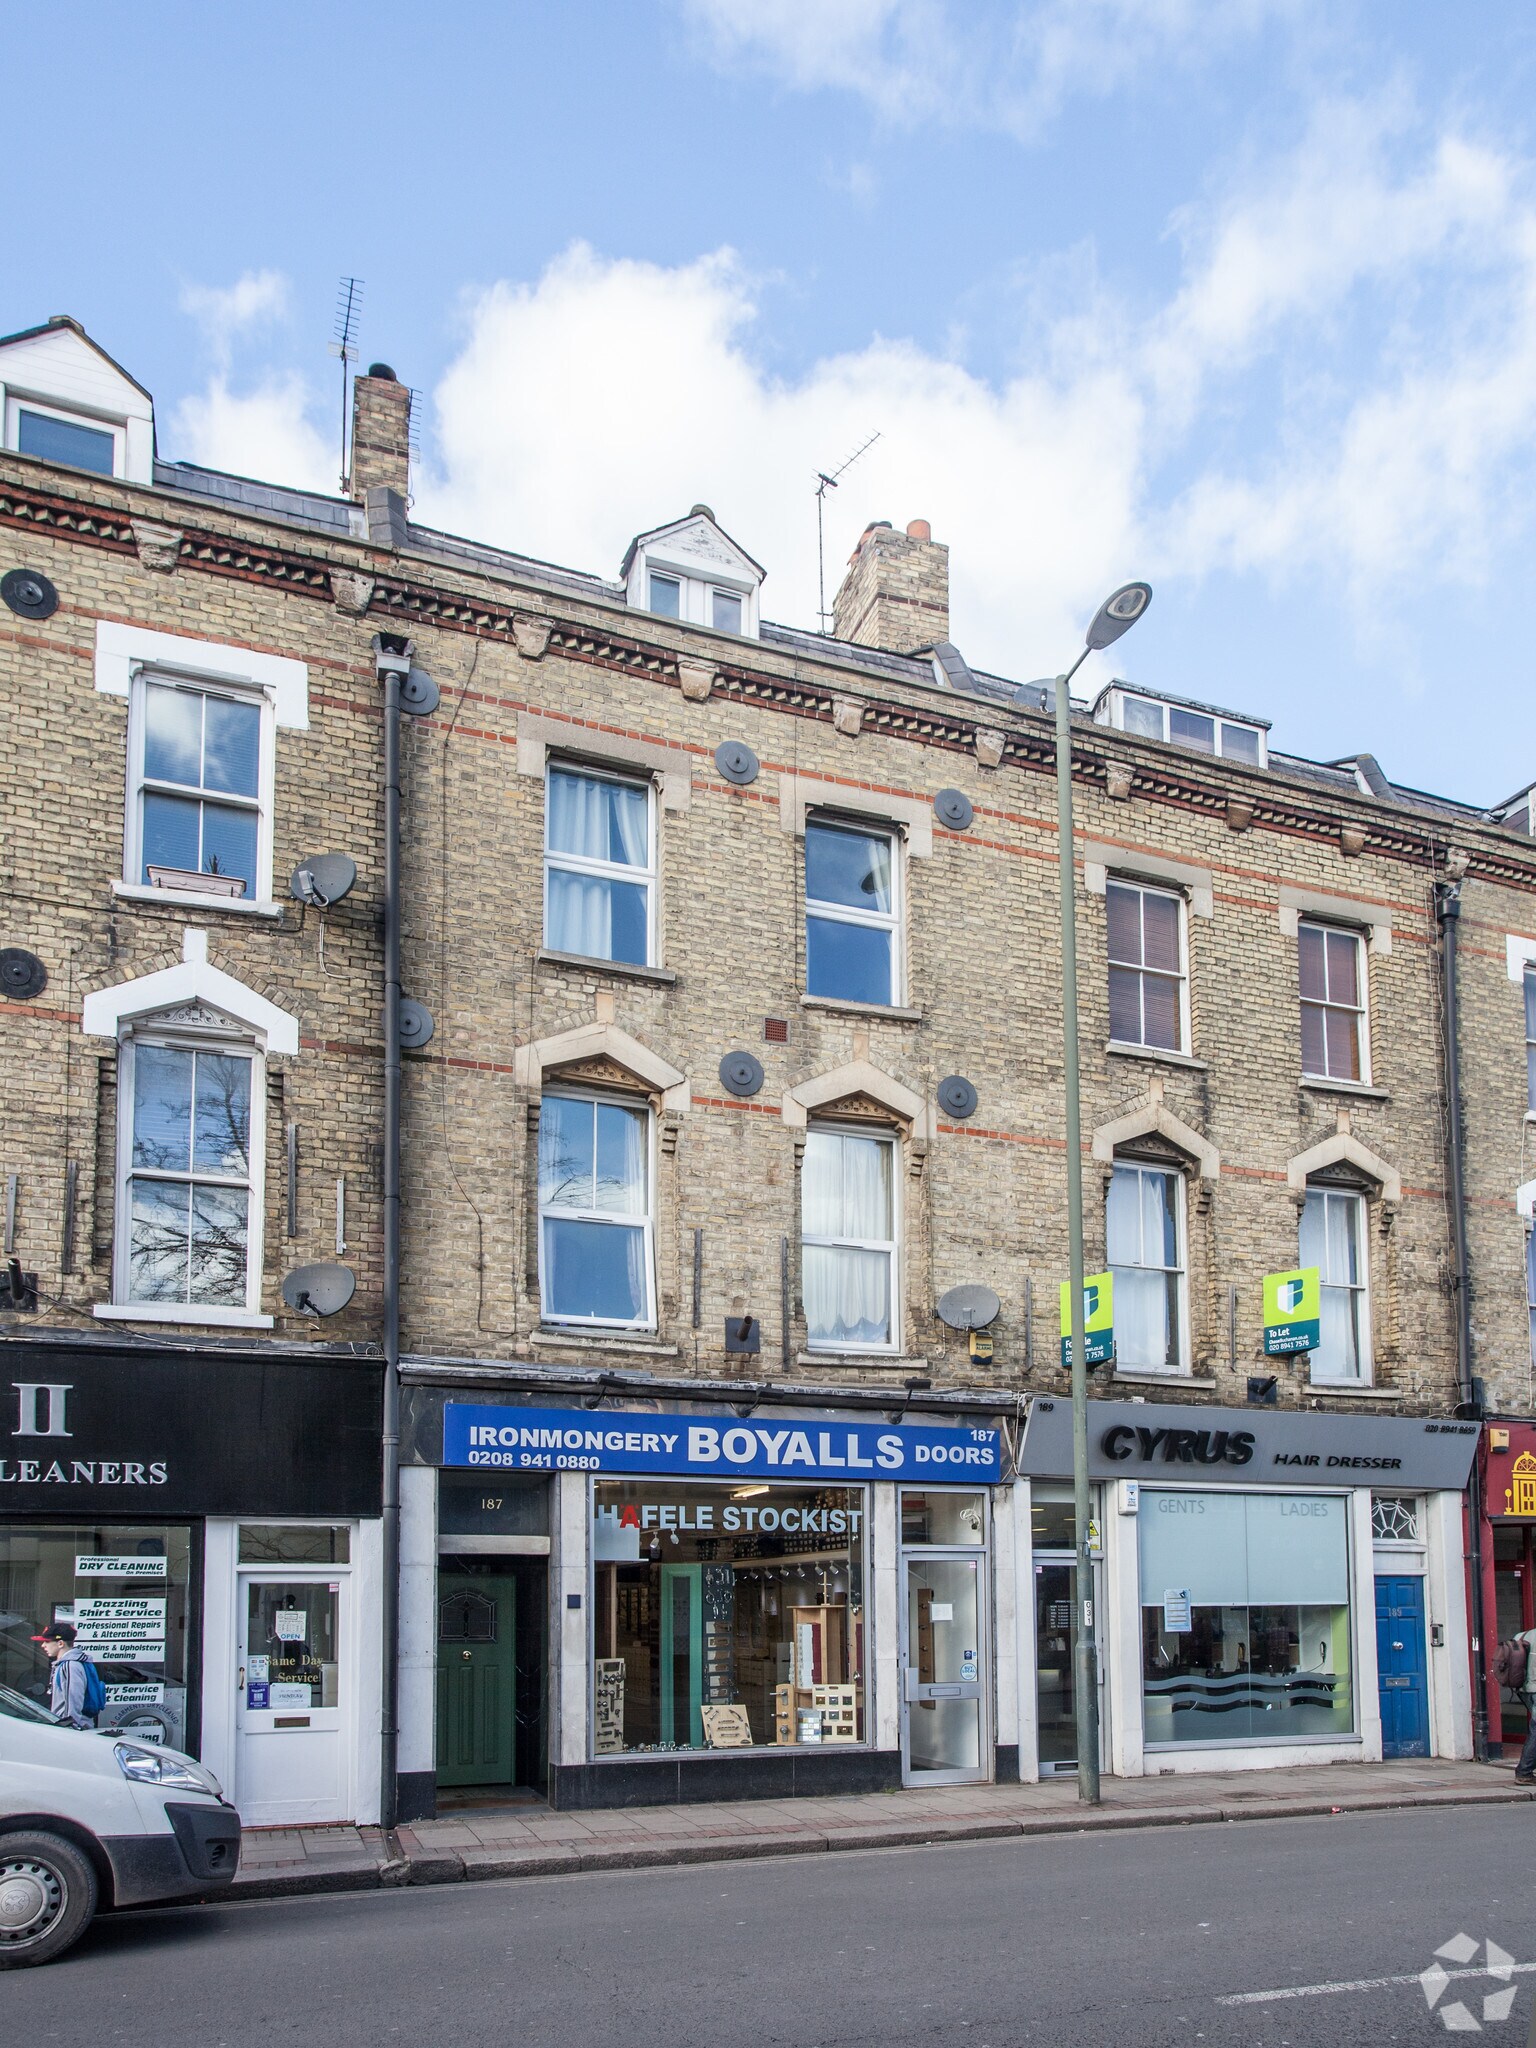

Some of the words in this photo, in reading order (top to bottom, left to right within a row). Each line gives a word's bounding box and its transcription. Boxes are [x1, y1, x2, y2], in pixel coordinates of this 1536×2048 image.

[1269, 1330, 1277, 1338] To
[1278, 1327, 1290, 1336] Let
[1269, 1343, 1279, 1351] 020
[1280, 1341, 1294, 1350] 8941
[1295, 1339, 1310, 1348] 7576
[1091, 1350, 1104, 1359] 7576
[11, 1382, 74, 1437] II
[1038, 1402, 1054, 1412] 189
[1424, 1424, 1439, 1433] 020
[1440, 1425, 1458, 1434] 8941
[970, 1429, 996, 1443] 187
[469, 1426, 679, 1453] IRONMONGERY
[687, 1426, 905, 1469] BOYALLS
[915, 1445, 995, 1465] DOORS
[1101, 1424, 1256, 1466] CYRUS
[1273, 1453, 1320, 1467] HAIR
[1326, 1456, 1402, 1470] DRESSER
[468, 1450, 514, 1466] 0208
[520, 1453, 551, 1468] 941
[556, 1455, 600, 1470] 0880
[481, 1498, 503, 1510] 187
[1158, 1499, 1205, 1514] GENTS
[1280, 1502, 1328, 1517] LADIES
[722, 1504, 864, 1533] STOCKIST
[78, 1562, 104, 1570] DRY
[106, 1562, 164, 1571] CLEANING
[93, 1600, 148, 1609] Dazzling
[79, 1609, 111, 1617] Shirt
[114, 1609, 162, 1617] Service
[1388, 1607, 1402, 1617] 189
[77, 1621, 129, 1630] Professional
[131, 1621, 161, 1630] Repairs
[100, 1630, 147, 1638] Alterations
[119, 1644, 162, 1652] Upholstery
[102, 1652, 136, 1660] Cleaning
[265, 1654, 296, 1666] Same
[301, 1654, 324, 1668] Day
[277, 1671, 319, 1683] Service
[113, 1694, 157, 1702] Cleaning
